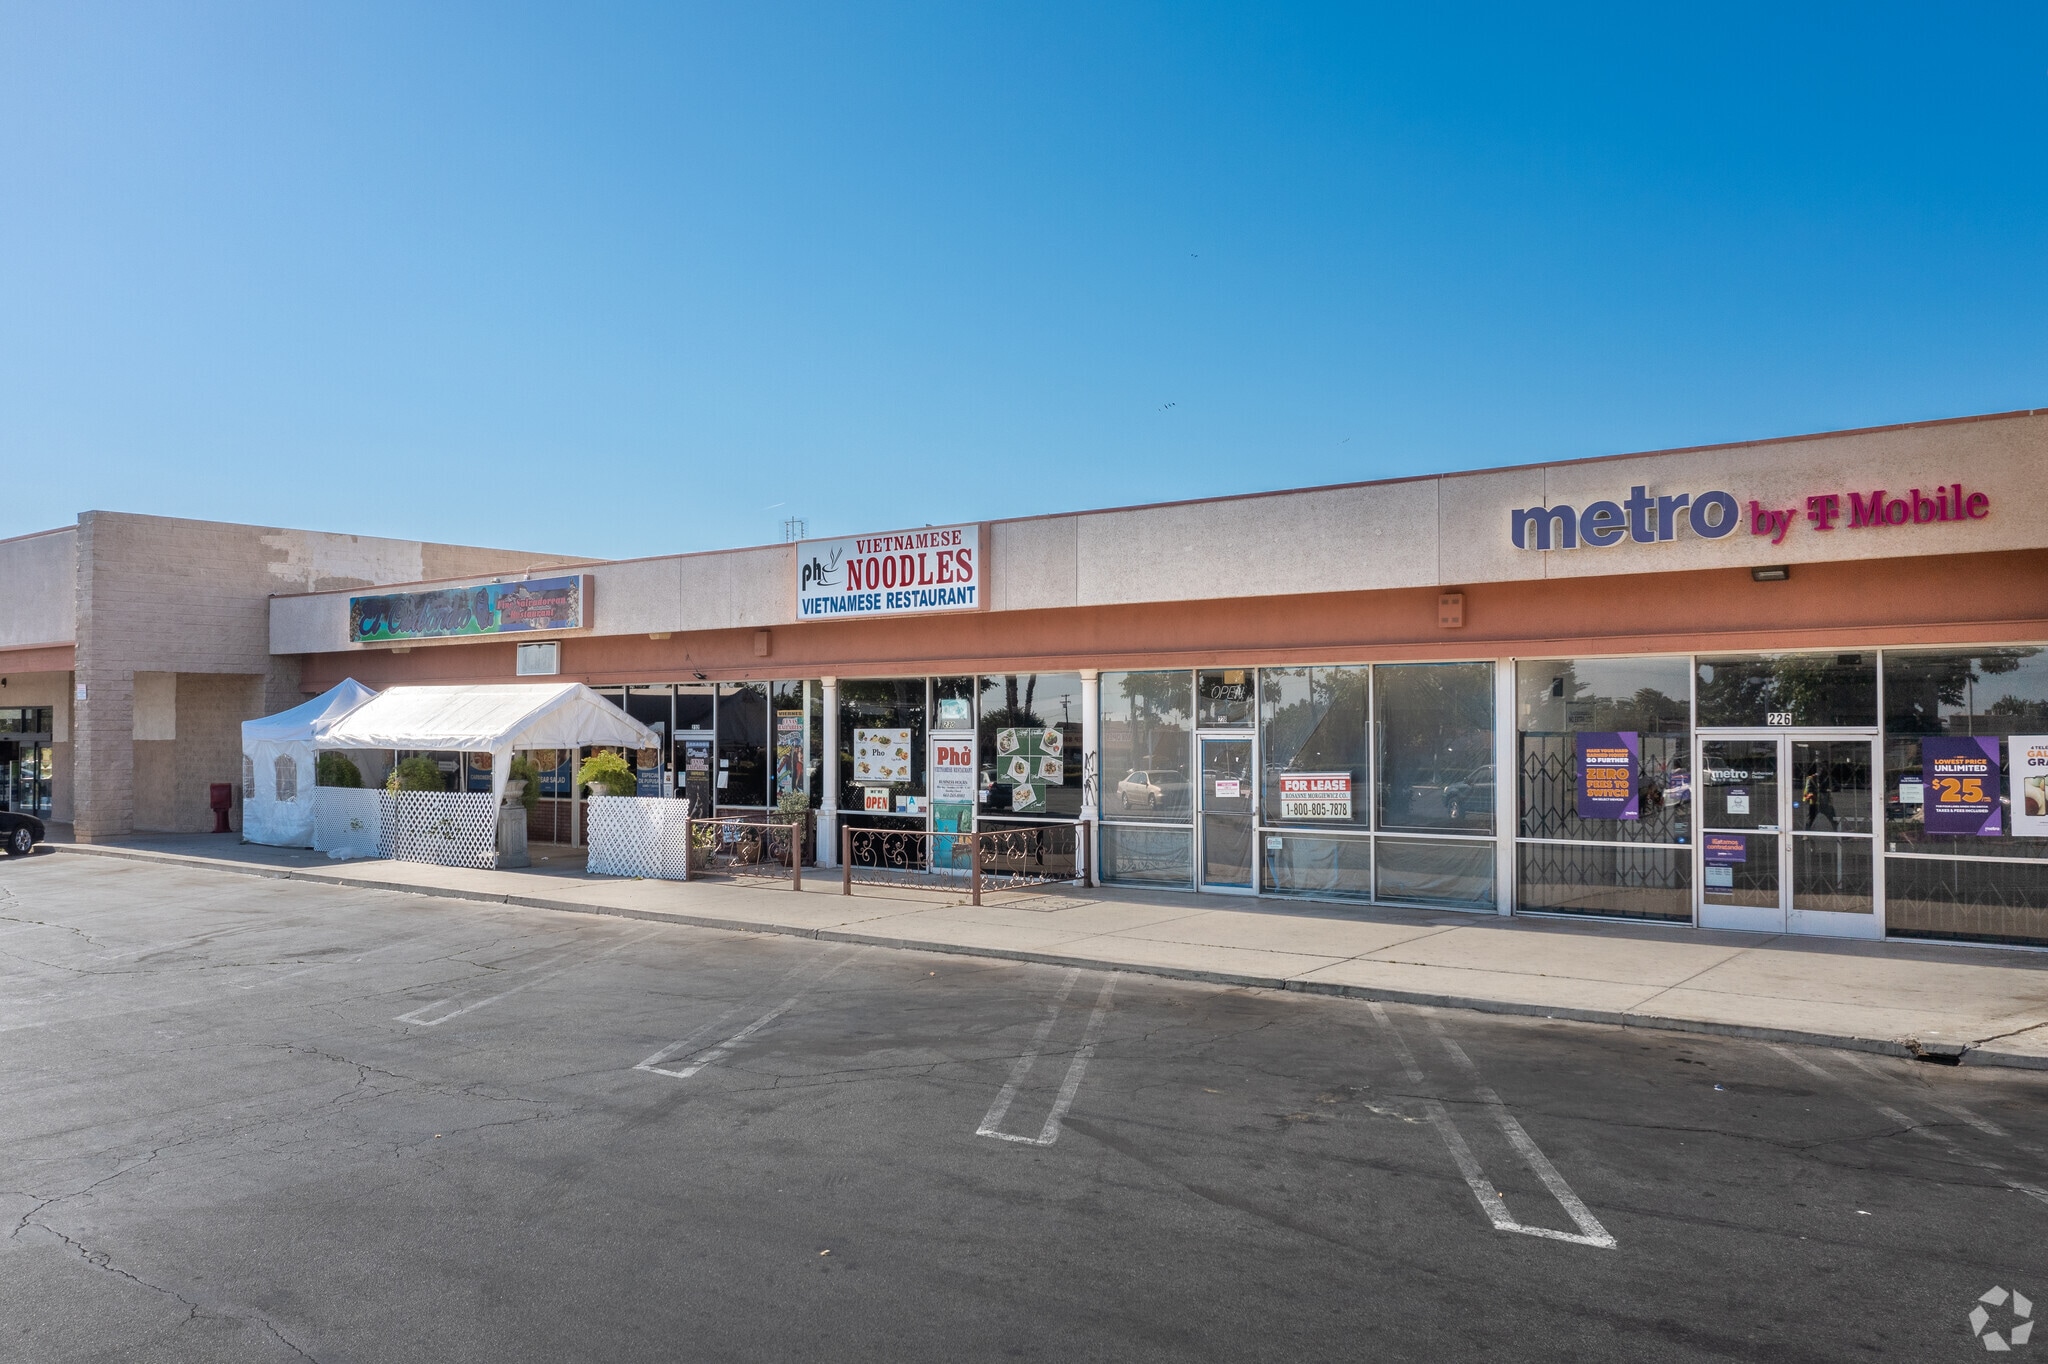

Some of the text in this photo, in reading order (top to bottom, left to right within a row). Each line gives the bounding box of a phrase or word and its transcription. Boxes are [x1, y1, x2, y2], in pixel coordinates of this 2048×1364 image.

[1511, 485, 1740, 551] metro
[1750, 500, 1795, 545] by
[1847, 483, 1990, 528] Mobile
[856, 529, 962, 554] VIETNAMESE
[846, 548, 974, 591] NOODLES
[802, 586, 976, 615] VIETNAMESE RESTAURANT
[1769, 713, 1791, 725] 226
[872, 748, 885, 756] Pho
[1586, 768, 1629, 779] ZERO
[1934, 764, 1987, 772] UNLIMITED
[1712, 769, 1748, 779] metro
[1284, 780, 1346, 791] FOR LEASE
[1586, 780, 1629, 788] FEES TO
[1587, 789, 1629, 797] SWITCH
[1931, 777, 1984, 803] $25
[866, 796, 887, 809] OPEN
[908, 795, 915, 805] A
[1286, 803, 1347, 816] 1-800-805-7878
